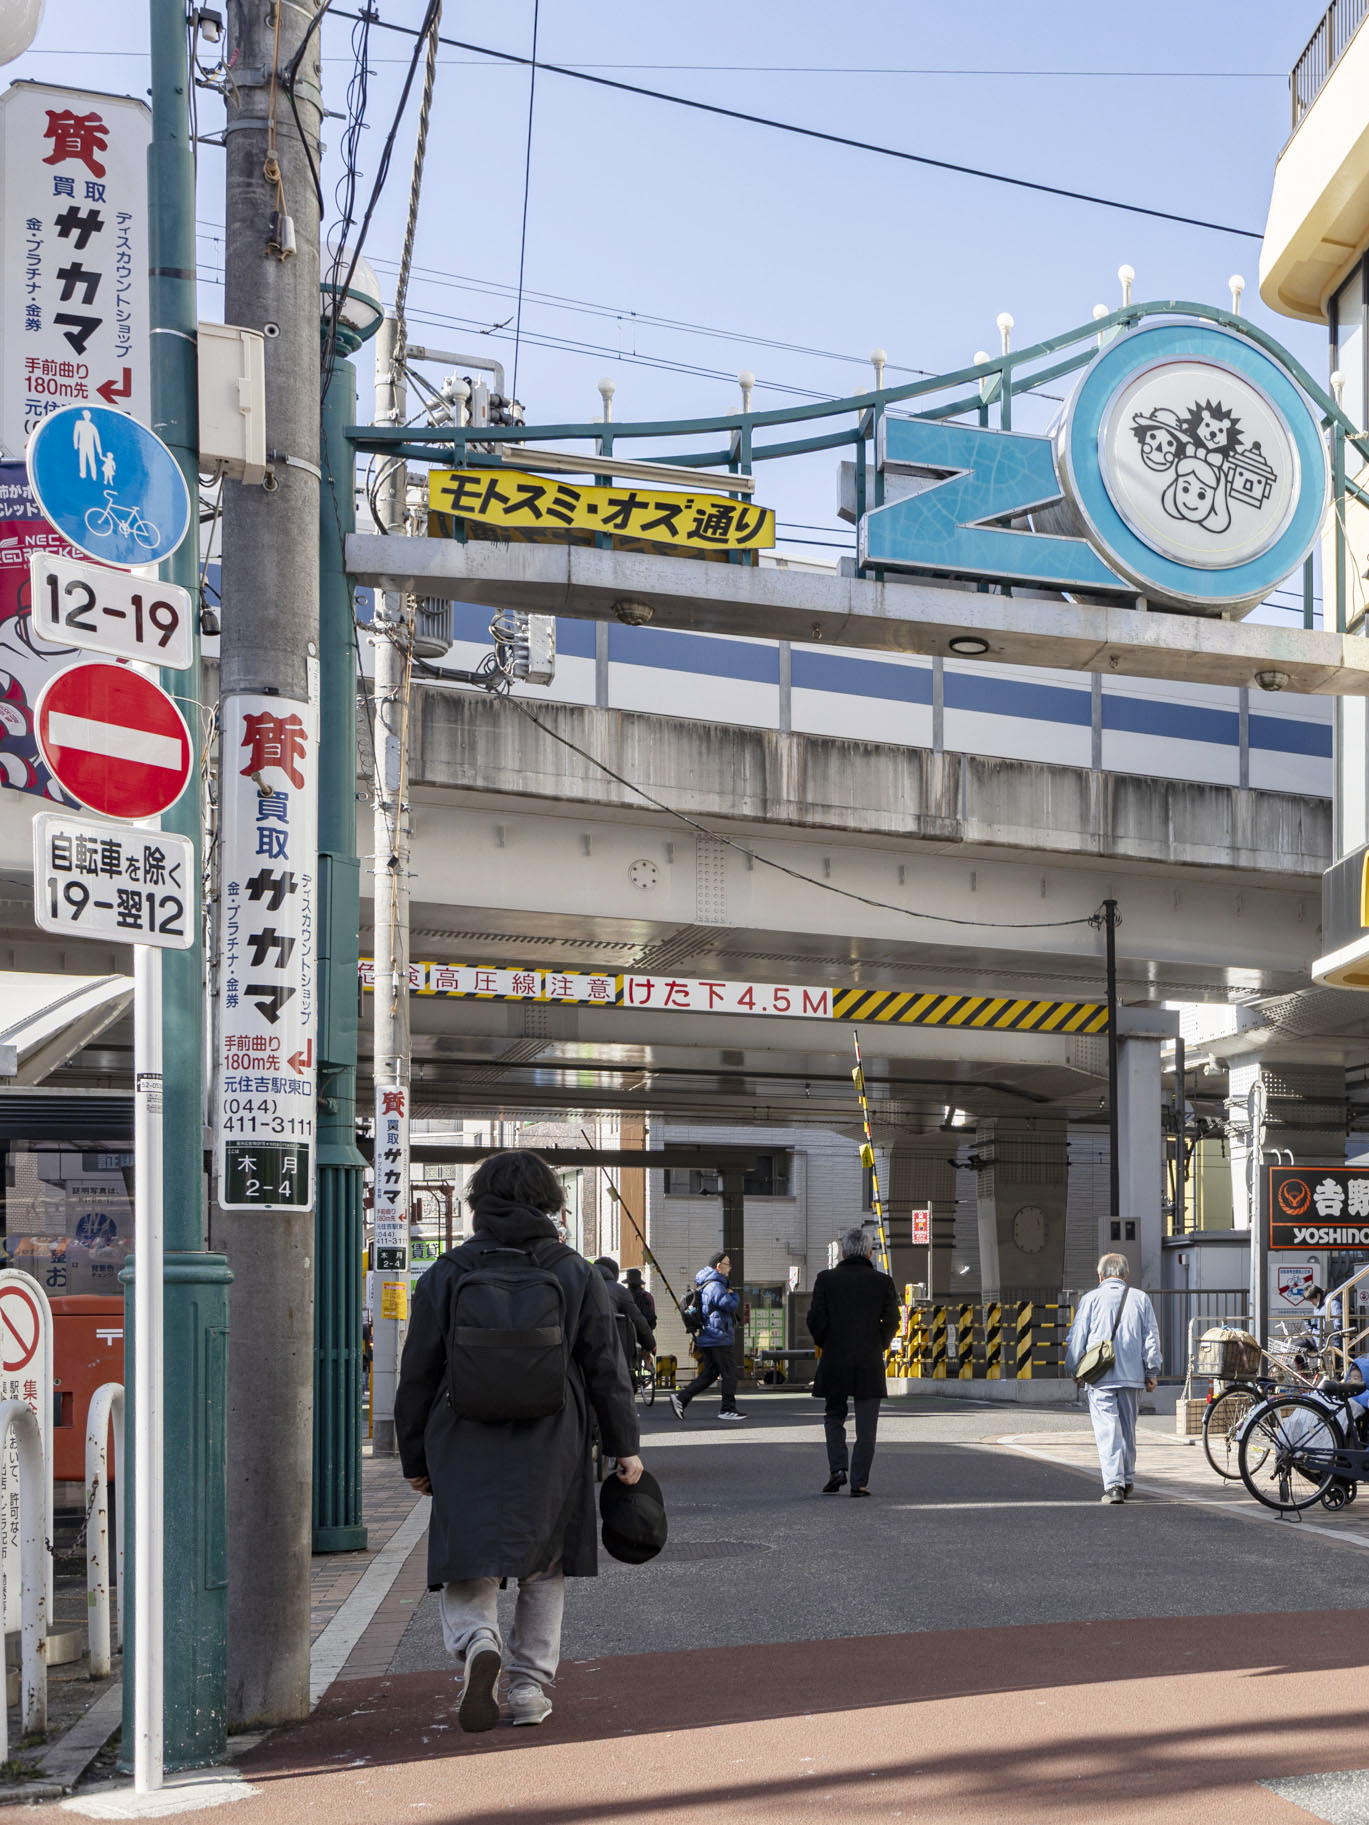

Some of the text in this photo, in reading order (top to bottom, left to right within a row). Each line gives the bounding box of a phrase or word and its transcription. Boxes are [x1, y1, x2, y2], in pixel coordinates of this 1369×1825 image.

[42, 109, 109, 179] 質
[52, 175, 107, 203] 買取
[25, 217, 42, 332] 金・プラチナ・金券
[53, 205, 104, 356] サカマ
[115, 211, 133, 358] ディスカウントショップ
[24, 376, 89, 400] 180m先
[25, 356, 89, 380] 手前曲り
[441, 474, 767, 545] モトスミ・オズ通り
[25, 534, 60, 546] NEC
[46, 573, 180, 648] 12-19
[240, 712, 308, 790] 質
[256, 789, 289, 860] 買取
[51, 831, 182, 889] 自転車を除く
[47, 877, 184, 937] 19-翌12
[226, 881, 240, 1009] 金・プラチナ・金券
[244, 868, 298, 1024] サカマ
[301, 873, 314, 1025] ディスカウントショップ
[435, 967, 537, 995] 高圧線
[550, 975, 612, 1000] 注意
[224, 1035, 281, 1052] 手前曲り
[224, 1053, 281, 1072] 180m先
[223, 1099, 278, 1115] (044)
[224, 1076, 312, 1096] 元住吉駅東口
[223, 1116, 312, 1136] 411-3111
[245, 1179, 292, 1198] 2-4
[383, 1148, 402, 1205] サカマ
